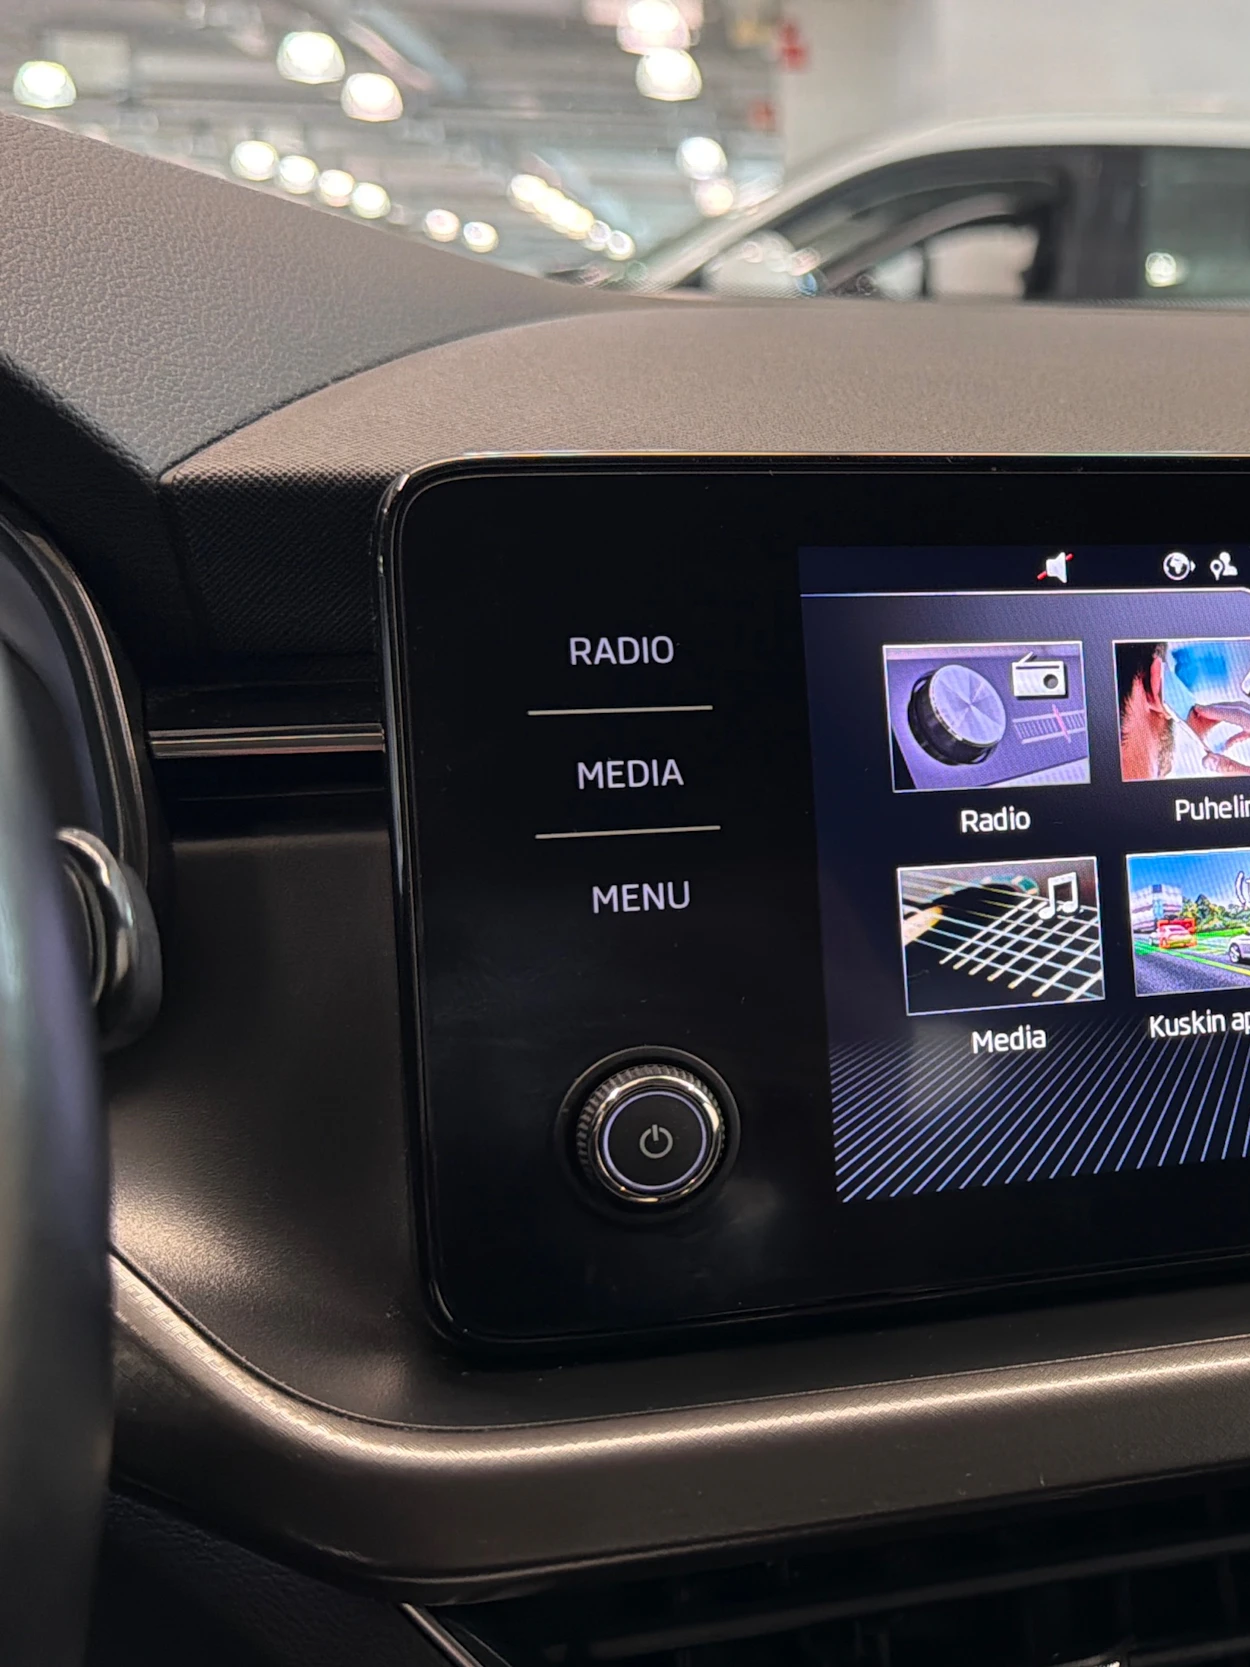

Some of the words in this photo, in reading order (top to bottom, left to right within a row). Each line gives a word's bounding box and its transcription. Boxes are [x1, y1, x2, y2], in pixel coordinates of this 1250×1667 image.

[569, 635, 674, 665] RADIO
[577, 759, 684, 790] MEDIA
[960, 806, 1031, 833] Radio
[592, 880, 690, 914] MENU
[1149, 1010, 1226, 1039] Kuskin
[971, 1025, 1047, 1054] Media
